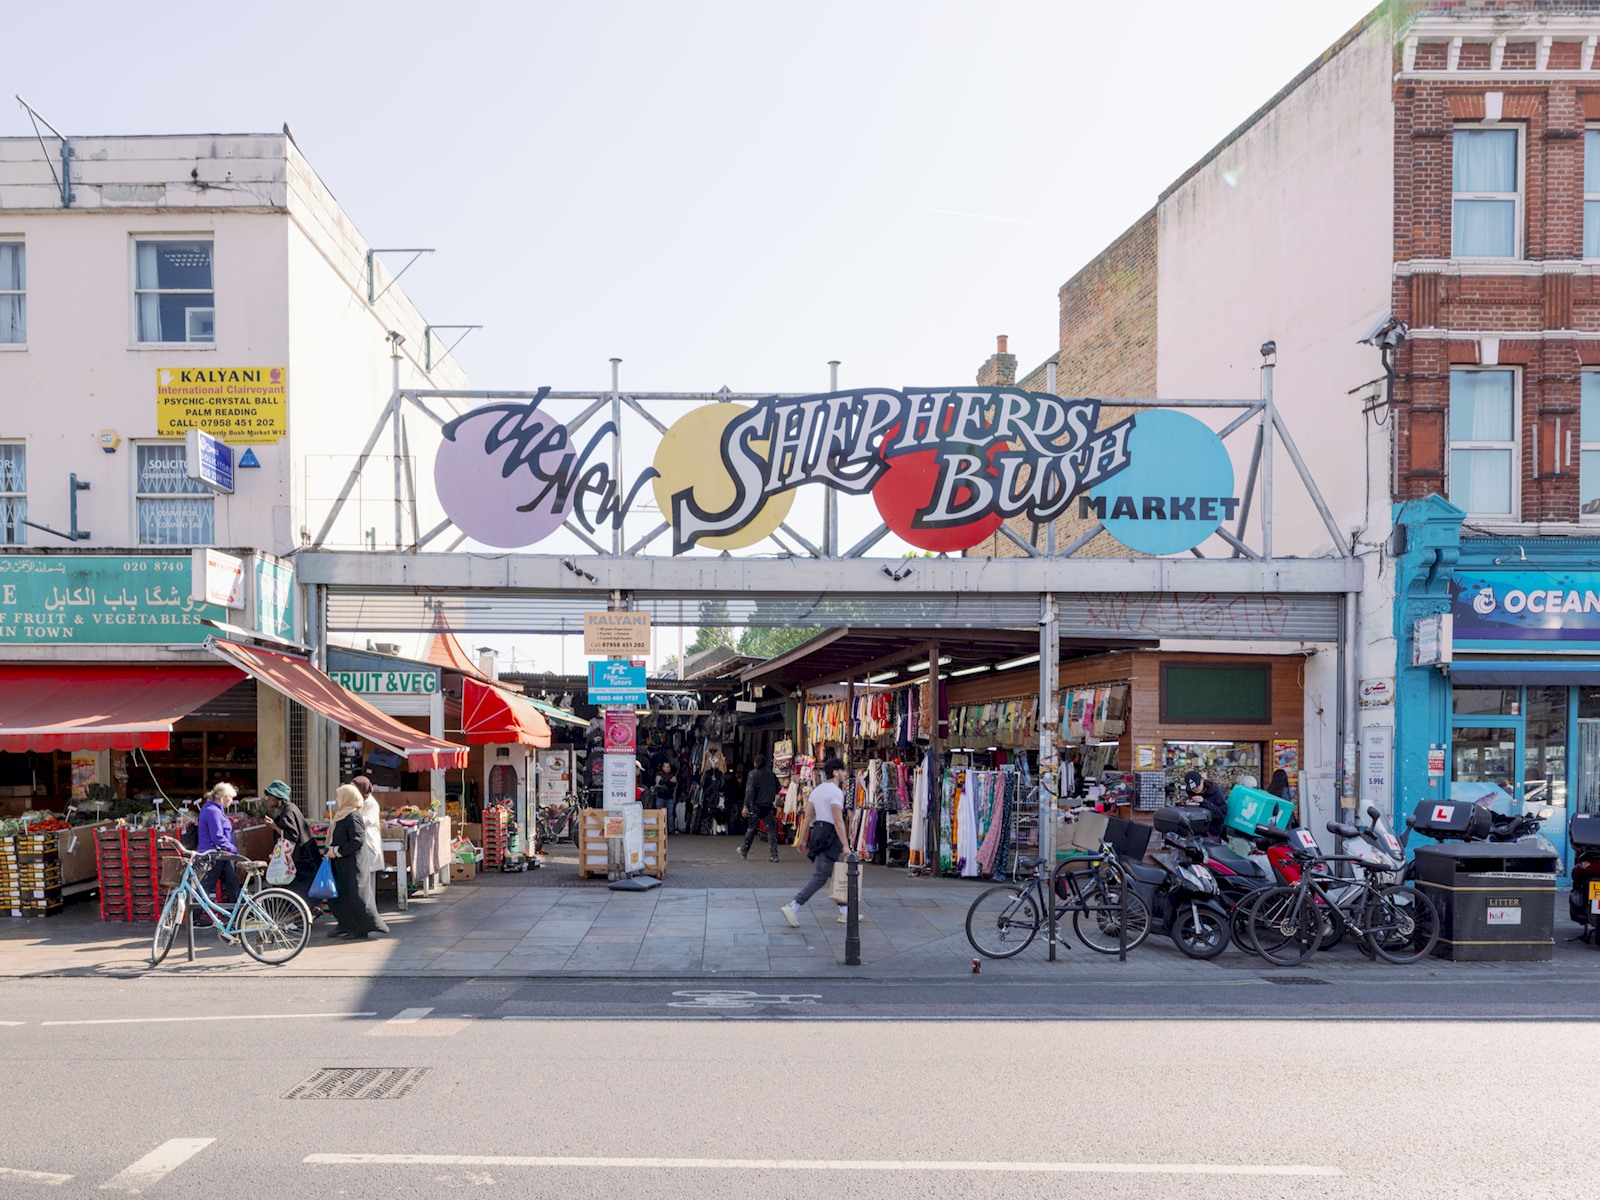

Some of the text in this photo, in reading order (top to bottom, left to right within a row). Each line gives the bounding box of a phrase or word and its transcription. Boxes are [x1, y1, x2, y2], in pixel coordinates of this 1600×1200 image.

[181, 371, 261, 383] KALYANI
[158, 385, 285, 396] International Clairvoyant
[254, 397, 278, 405] BALL
[215, 408, 257, 416] READING
[169, 419, 198, 427] CALL:
[201, 419, 231, 427] 07958
[200, 452, 232, 474] SOLICITORS
[672, 387, 1102, 556] SHEPHERDS
[910, 413, 1136, 529] BUSH
[1078, 495, 1240, 522] MARKET
[123, 561, 184, 571] 020 8740
[103, 587, 138, 611] باب
[1503, 589, 1600, 614] OCEAN
[14, 612, 67, 625] FRUIT
[74, 613, 84, 625] &
[92, 612, 201, 626] VEGETABLES
[589, 615, 647, 625] KALYANI
[24, 626, 74, 638] TOWN
[602, 673, 619, 681] Fine
[1436, 808, 1448, 819] L
[1302, 834, 1313, 844] L
[1489, 898, 1520, 906] LITTER
